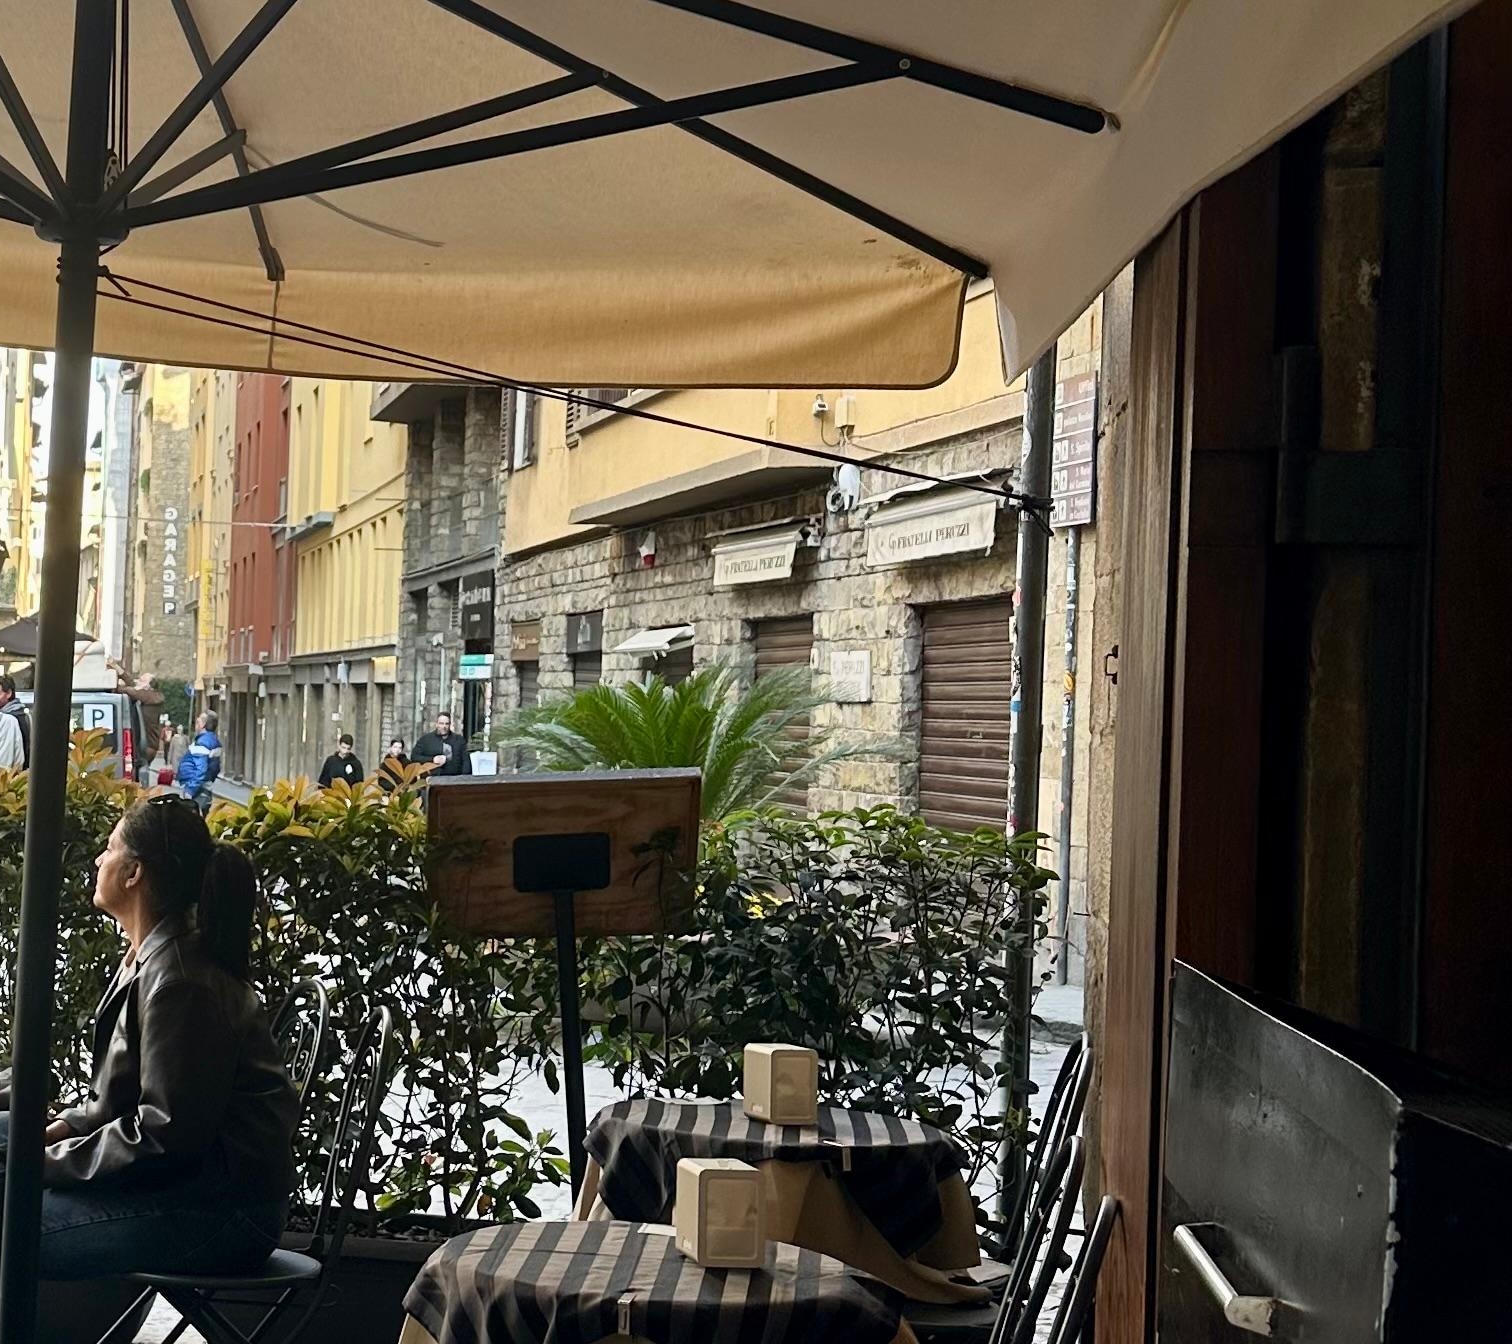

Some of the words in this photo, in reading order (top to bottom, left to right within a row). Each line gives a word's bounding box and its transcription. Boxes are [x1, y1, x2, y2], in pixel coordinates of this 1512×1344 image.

[897, 530, 933, 549] FRATELLI
[935, 523, 970, 542] PERUZZI
[92, 708, 105, 728] P
